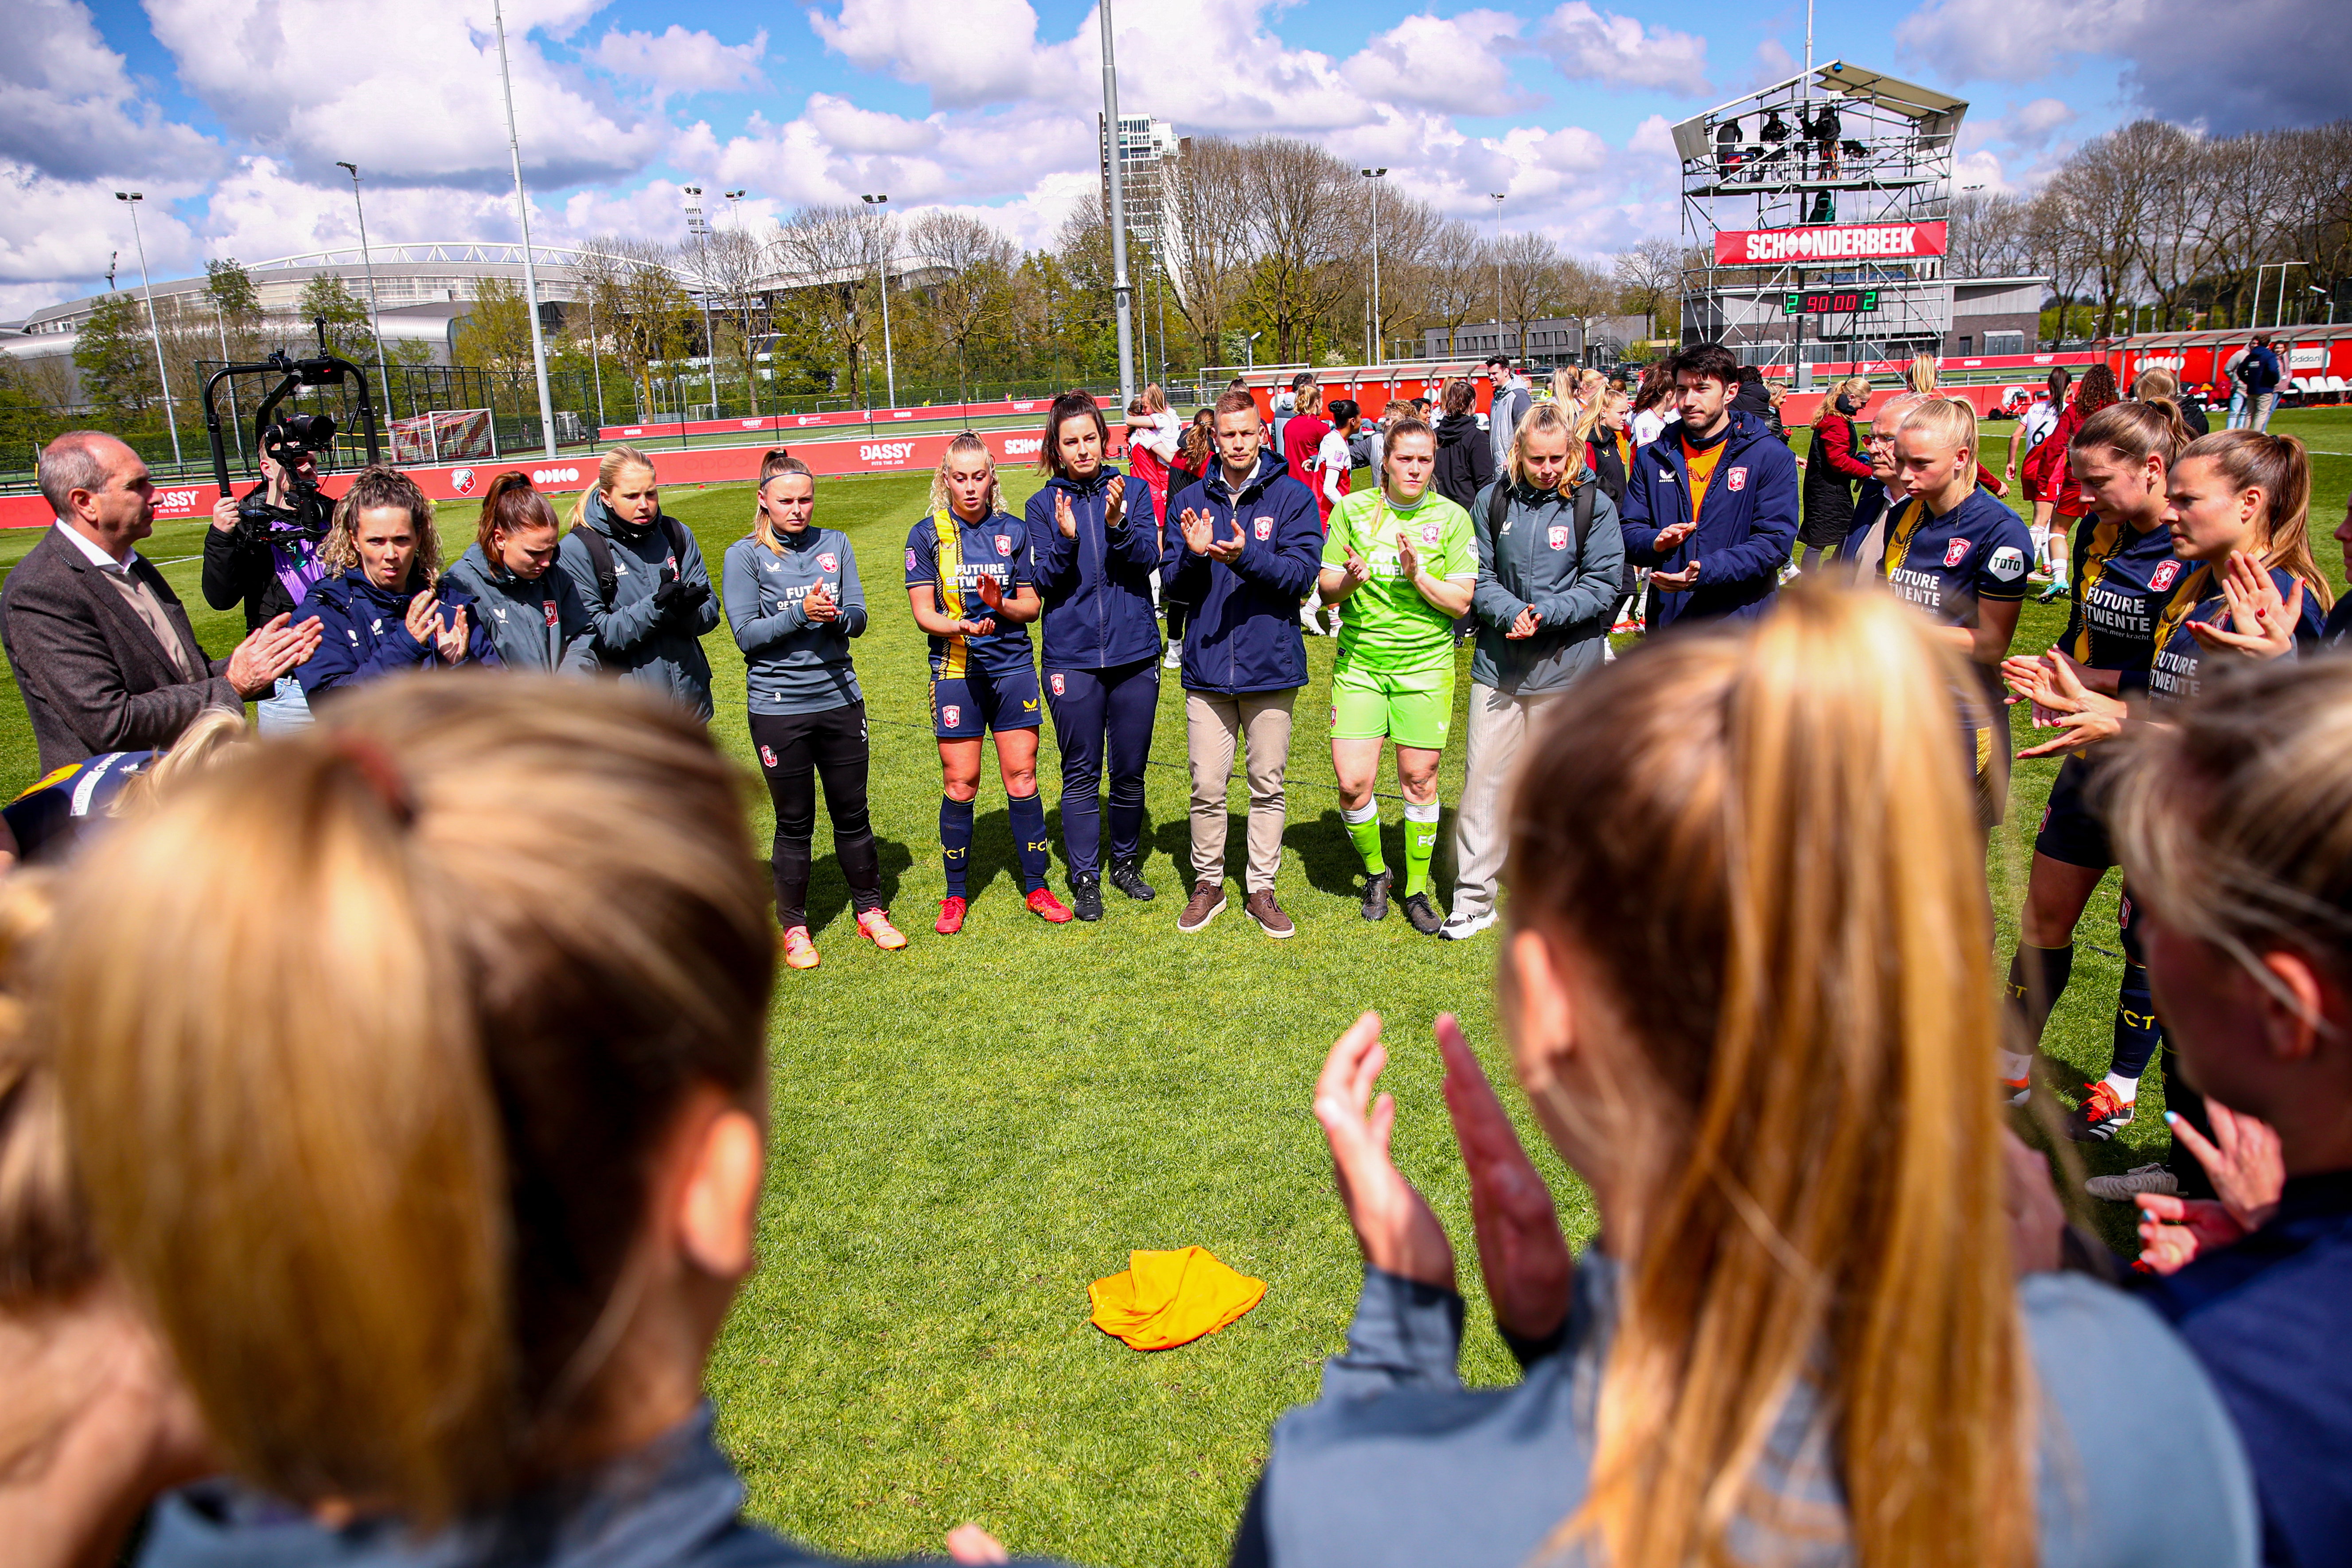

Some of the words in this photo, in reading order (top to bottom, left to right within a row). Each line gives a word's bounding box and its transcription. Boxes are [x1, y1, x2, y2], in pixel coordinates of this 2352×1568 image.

[2032, 421, 2049, 446] 6
[955, 563, 1005, 576] FUTURE
[1994, 557, 2021, 572] TOTO
[946, 576, 957, 586] OF
[1889, 567, 1940, 590] FUTURE
[2086, 586, 2145, 614] FUTURE
[2086, 604, 2150, 632] TWENTE
[2153, 650, 2198, 677] FUTURE
